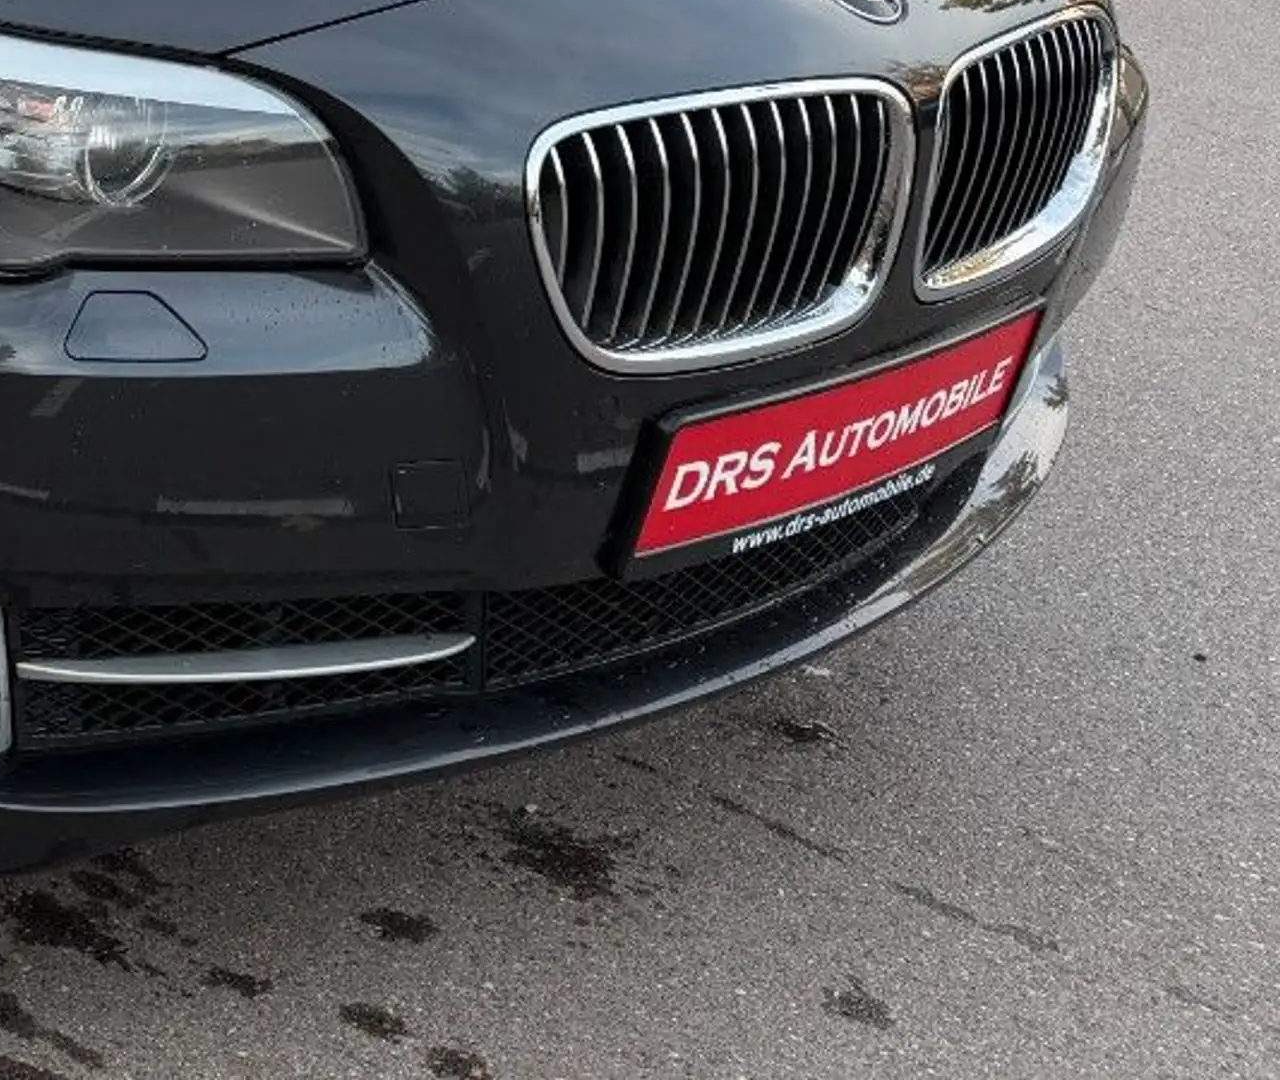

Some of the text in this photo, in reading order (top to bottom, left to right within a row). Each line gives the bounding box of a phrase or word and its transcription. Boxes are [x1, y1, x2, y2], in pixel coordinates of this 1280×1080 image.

[663, 356, 1013, 512] DRS AUTOMOBILE
[731, 464, 937, 554] www.drs-automobile.de
